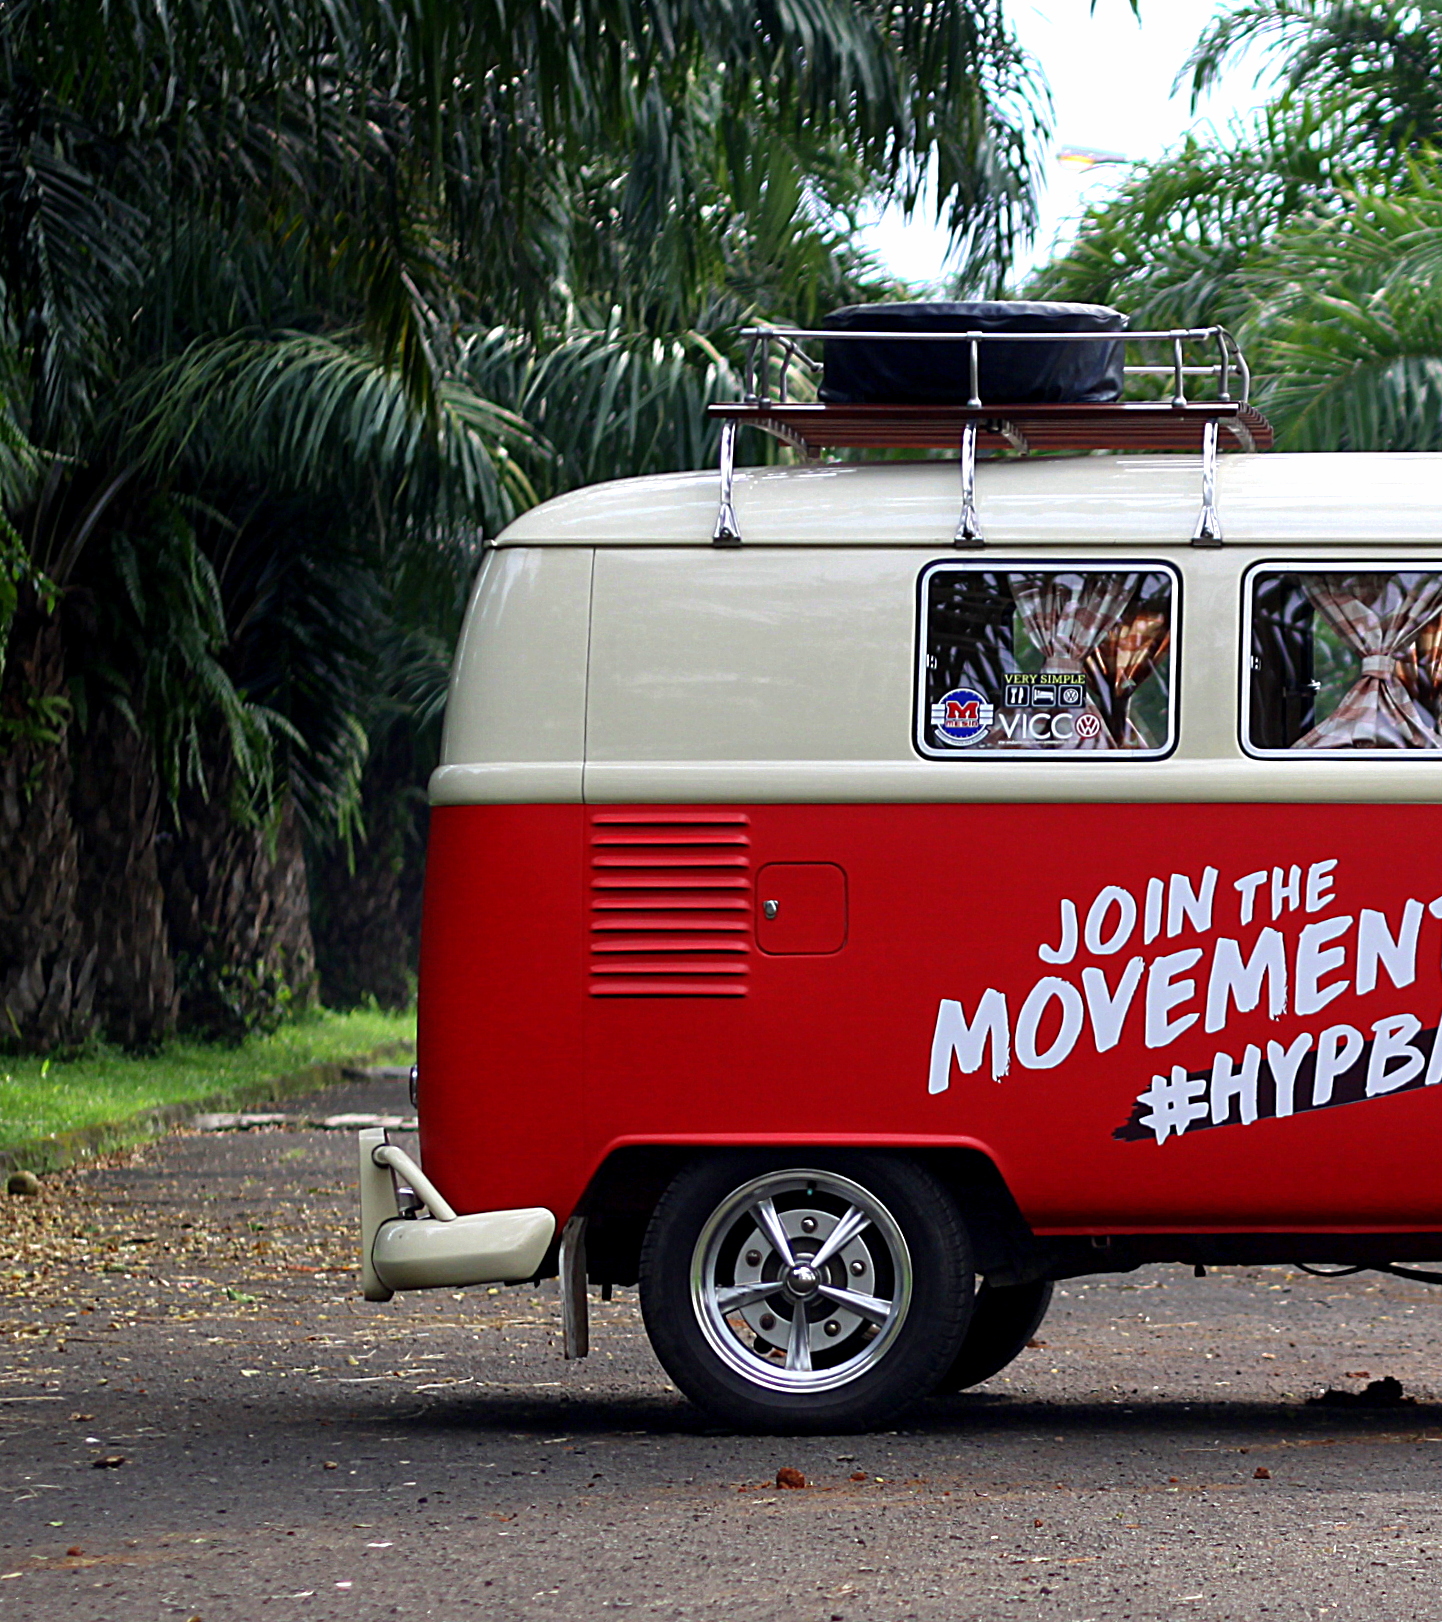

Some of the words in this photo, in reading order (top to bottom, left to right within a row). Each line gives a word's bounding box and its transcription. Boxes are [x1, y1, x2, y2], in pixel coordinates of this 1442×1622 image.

[1004, 674, 1038, 684] VERY
[1040, 674, 1086, 684] SIMPLE
[945, 700, 980, 719] M
[998, 713, 1073, 739] VICC
[1039, 866, 1218, 964] JOIN
[1234, 859, 1337, 926] THE
